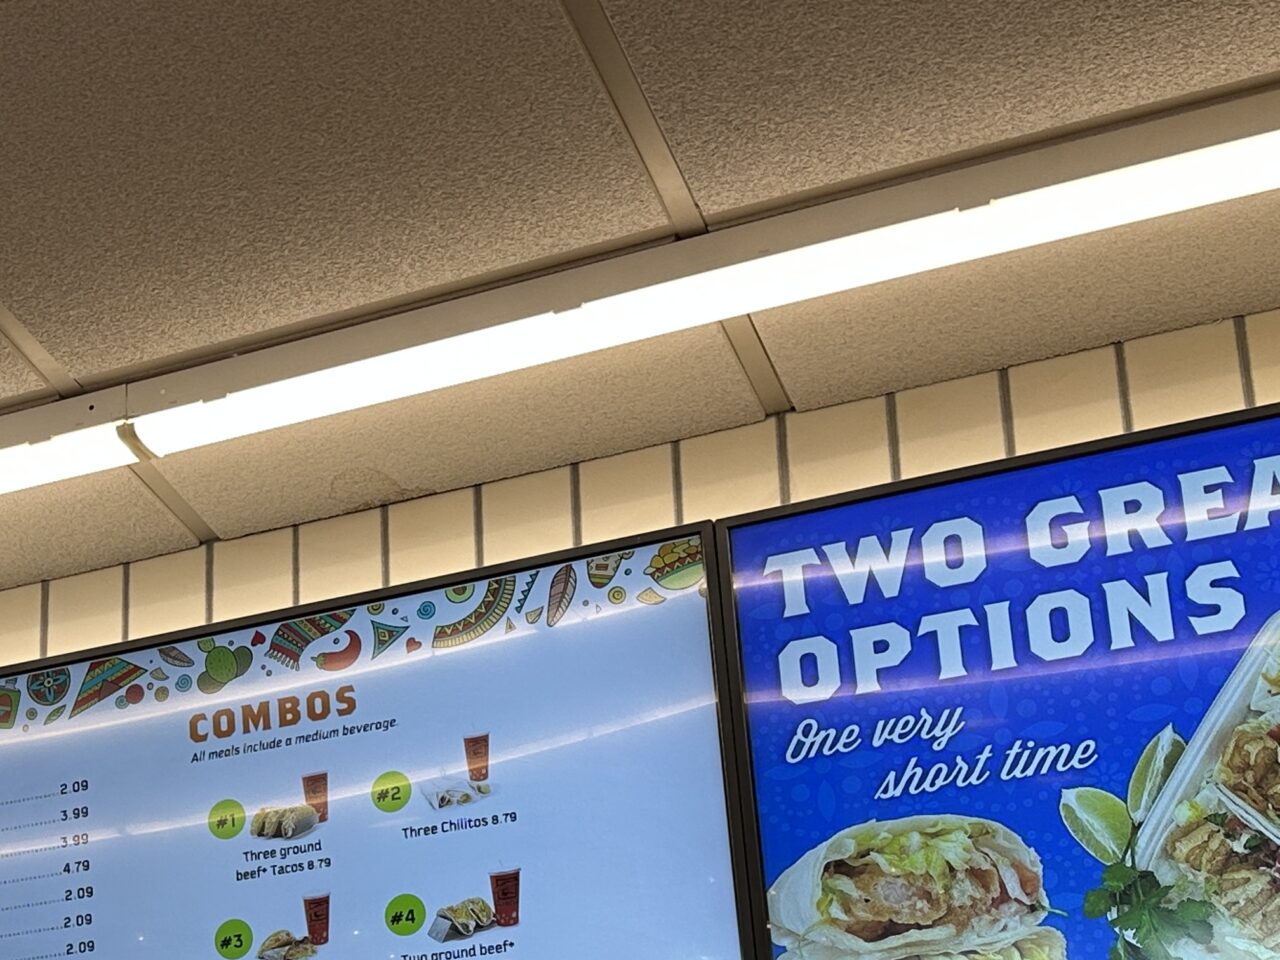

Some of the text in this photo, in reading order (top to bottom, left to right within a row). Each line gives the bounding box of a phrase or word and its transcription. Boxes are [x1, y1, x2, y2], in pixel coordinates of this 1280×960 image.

[764, 516, 988, 618] TWO
[777, 561, 1246, 705] OPTIONS
[188, 685, 356, 742] COMBOS
[785, 705, 966, 764] One very
[190, 750, 205, 763] All
[208, 745, 240, 759] meals
[243, 737, 282, 753] include
[285, 737, 291, 746] a
[295, 728, 339, 743] medium
[874, 735, 1099, 801] short time
[60, 779, 88, 794] 2.09
[374, 786, 403, 805] #2
[59, 806, 89, 823] 3.99
[213, 814, 235, 833] #1
[401, 811, 516, 838] Three Chilitos 8.79
[242, 839, 322, 861] Three ground
[269, 857, 304, 875] Tacos
[307, 857, 331, 870] 8.79
[64, 886, 93, 900] 2.09
[390, 909, 415, 925] #4
[220, 933, 243, 949] #3
